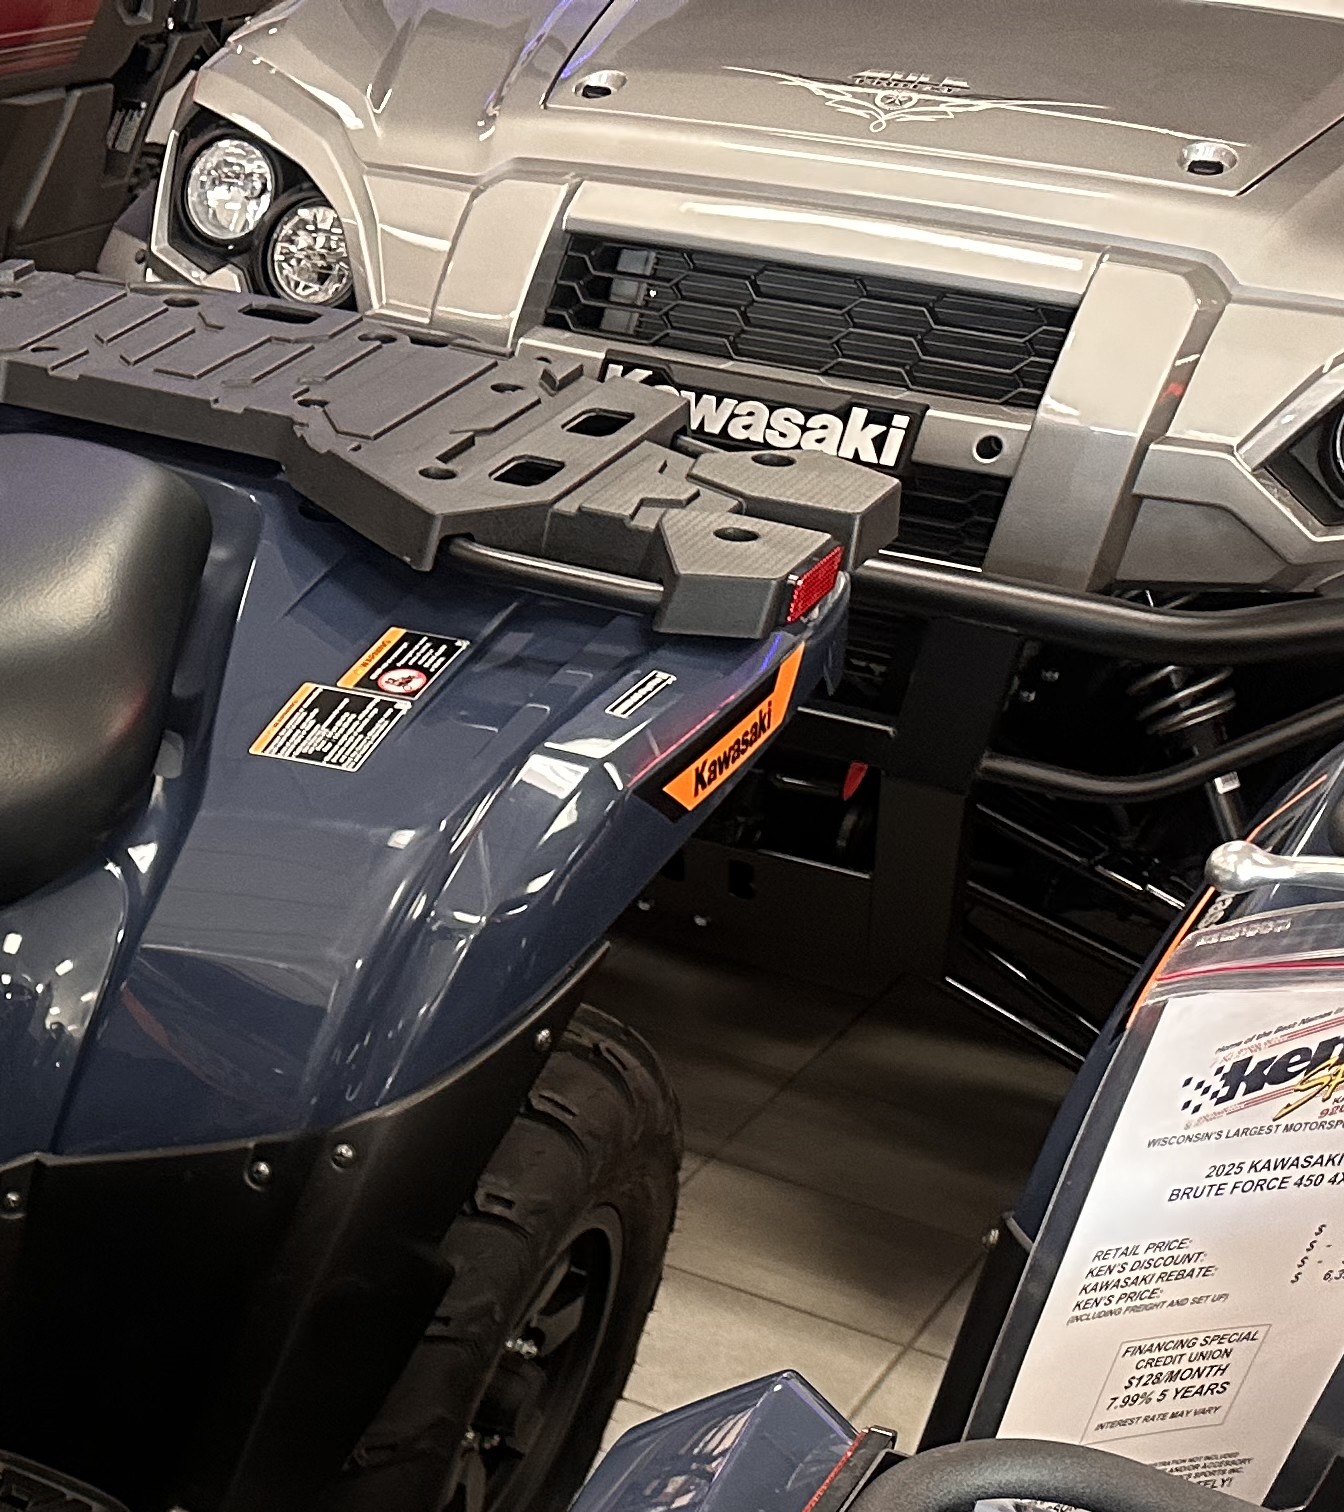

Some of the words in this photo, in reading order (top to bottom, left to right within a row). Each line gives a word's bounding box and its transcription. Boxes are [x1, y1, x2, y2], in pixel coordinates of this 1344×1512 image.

[607, 362, 912, 468] wasaki
[693, 700, 773, 798] Kawasaki
[1147, 1130, 1223, 1149] WISCONSIN'S
[1224, 1123, 1282, 1140] LARGEST
[1205, 1161, 1246, 1179] 2025
[1247, 1153, 1344, 1174] KAWASAKI
[1167, 1182, 1229, 1202] BRUTE
[1229, 1175, 1292, 1195] FORCE
[1293, 1173, 1325, 1189] 450
[1092, 1244, 1141, 1263] RETAIL
[1144, 1237, 1193, 1255] PRICE:
[1085, 1261, 1129, 1280] KEN'S
[1129, 1251, 1208, 1272] DISCOUNT:
[1078, 1273, 1156, 1296] KAWASAKI
[1155, 1265, 1219, 1284] REBATE:
[1072, 1294, 1115, 1312] KEN'S
[1116, 1287, 1164, 1306] PRICE:
[1166, 1296, 1189, 1309] AND
[1190, 1294, 1212, 1306] SET
[1121, 1337, 1199, 1358] FINANCING
[1199, 1330, 1260, 1348] SPECIAL
[1135, 1353, 1186, 1371] CREDIT
[1188, 1347, 1233, 1363] UNION
[1124, 1363, 1231, 1390] $128/MONTH
[1106, 1390, 1155, 1411] 7.99%
[1156, 1388, 1169, 1403] 5
[1172, 1381, 1231, 1401] YEARS
[1094, 1416, 1142, 1432] INTEREST
[1142, 1412, 1169, 1425] RATE
[1169, 1408, 1193, 1420] MAY
[1193, 1405, 1222, 1416] VARY
